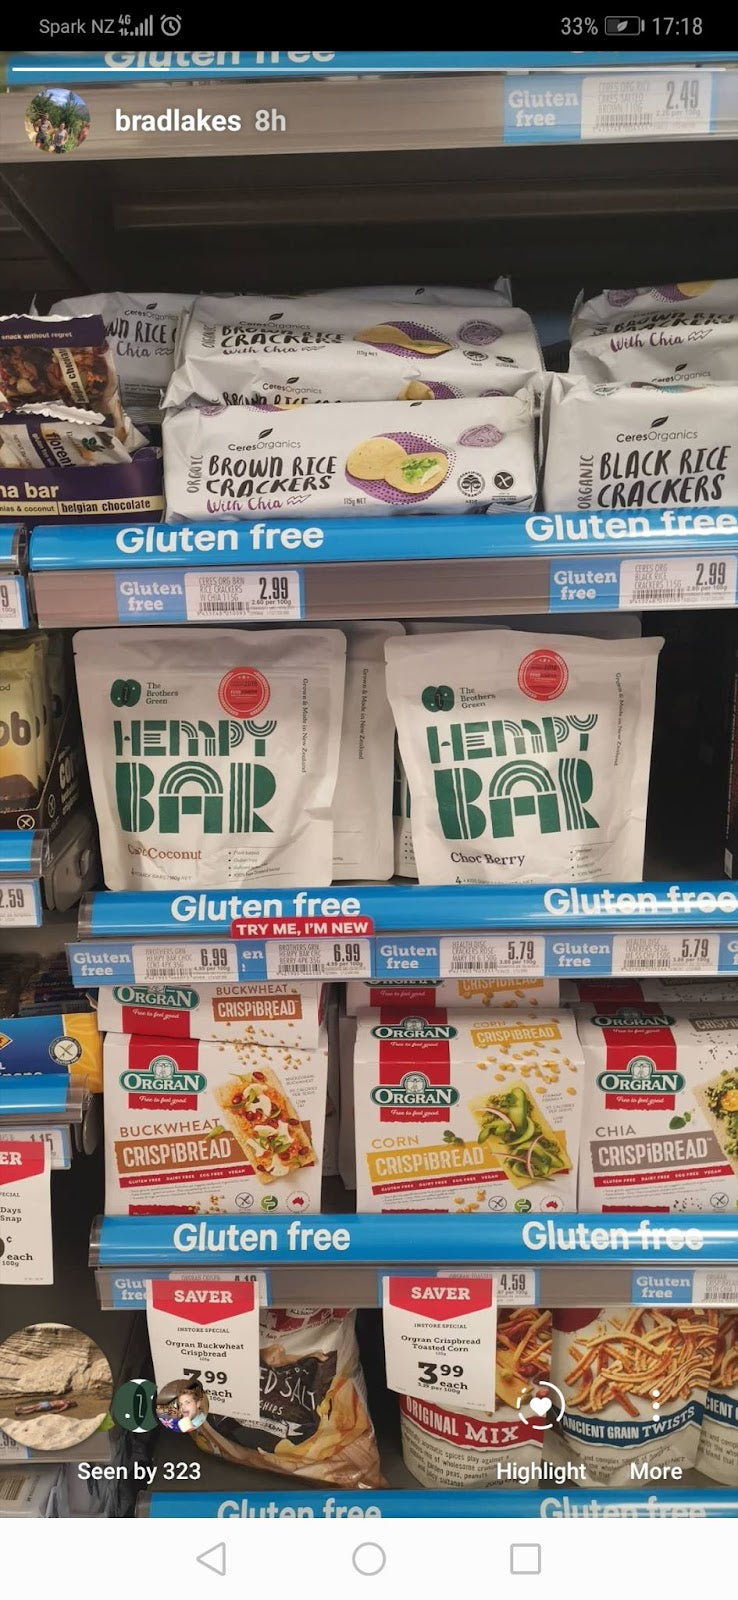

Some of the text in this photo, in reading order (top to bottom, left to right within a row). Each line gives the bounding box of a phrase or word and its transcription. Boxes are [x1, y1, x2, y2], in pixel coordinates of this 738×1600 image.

[508, 89, 579, 108] Gluten
[665, 79, 700, 110] 2.49
[515, 110, 556, 127] free
[116, 341, 150, 357] Chia
[610, 331, 685, 353] With Chia
[616, 429, 699, 443] CeresOrganics
[228, 440, 301, 452] CeresOrganics
[208, 455, 338, 478] BROWN RICE
[599, 445, 732, 481] BLACK RICE
[206, 475, 333, 499] CRACKERS
[577, 454, 595, 510] ORGANIC
[597, 473, 726, 509] CRACKERS
[61, 500, 151, 514] belgian chocolate
[206, 496, 282, 514] With Chia
[524, 510, 738, 542] Gluten free
[115, 523, 324, 555] Gluten free
[553, 570, 618, 586] Gluten
[695, 561, 727, 587] 2.99
[119, 581, 183, 596] Gluten
[259, 576, 289, 600] 2.99
[560, 586, 596, 600] free
[127, 597, 164, 612] free
[146, 682, 161, 690] The
[146, 689, 179, 697] Brothers
[459, 687, 476, 695] The
[145, 697, 168, 705] Green
[460, 693, 496, 702] Brothers
[461, 701, 486, 710] Green
[113, 719, 278, 757] HEMPY
[426, 713, 599, 765] HEMPY
[115, 761, 277, 834] BAR
[434, 757, 600, 840] BAR
[147, 847, 203, 861] Coconut
[450, 851, 526, 867] Choc Berry
[170, 892, 361, 923] Gluten free
[543, 885, 738, 916] Gluten free
[236, 921, 369, 937] TRY ME, I'M NEW
[333, 943, 360, 962] 6.99
[379, 945, 438, 958] Gluten
[507, 941, 534, 960] 5.79
[552, 942, 611, 956] Gluten
[681, 938, 709, 958] 5.79
[73, 952, 131, 964] Gluten
[200, 948, 228, 967] 6.99
[385, 958, 420, 970] free
[558, 956, 592, 968] free
[81, 964, 114, 976] free
[116, 985, 194, 1008] ORGRAN
[216, 984, 289, 995] BUCKWHEAT
[374, 1026, 451, 1039] ORGRAN
[122, 1074, 200, 1091] ORGRAN
[601, 1074, 679, 1091] ORGRAN
[138, 1095, 153, 1104] Free
[160, 1096, 173, 1105] feel
[374, 1089, 453, 1105] ORGRAN
[119, 1118, 221, 1138] BUCKWHEAT
[595, 1124, 637, 1138] CHIA
[371, 1135, 420, 1149] CORN
[0, 1206, 22, 1214] Days
[0, 1214, 22, 1224] Snap
[173, 1220, 351, 1252] Gluten free
[521, 1219, 705, 1251] Gluten free
[6, 1253, 33, 1261] each
[500, 1273, 526, 1291] 4.59
[636, 1275, 691, 1287] Gluten
[174, 1290, 234, 1304] SAVER
[411, 1286, 471, 1301] SAVER
[641, 1287, 673, 1298] free
[177, 1326, 231, 1335] INSTORE SPECIAL
[165, 1339, 245, 1350] Orgran Buckwheat
[400, 1335, 481, 1346] Orgran Crispbread
[411, 1343, 446, 1352] Toasted
[180, 1349, 228, 1358] Crispbread
[440, 1381, 468, 1390] each
[280, 1377, 316, 1411] SALT
[406, 1396, 519, 1444] ORIGINAL MIX
[562, 1405, 696, 1440] ANCIENT GRAIN TWISTS
[217, 1498, 382, 1518] Gluten free
